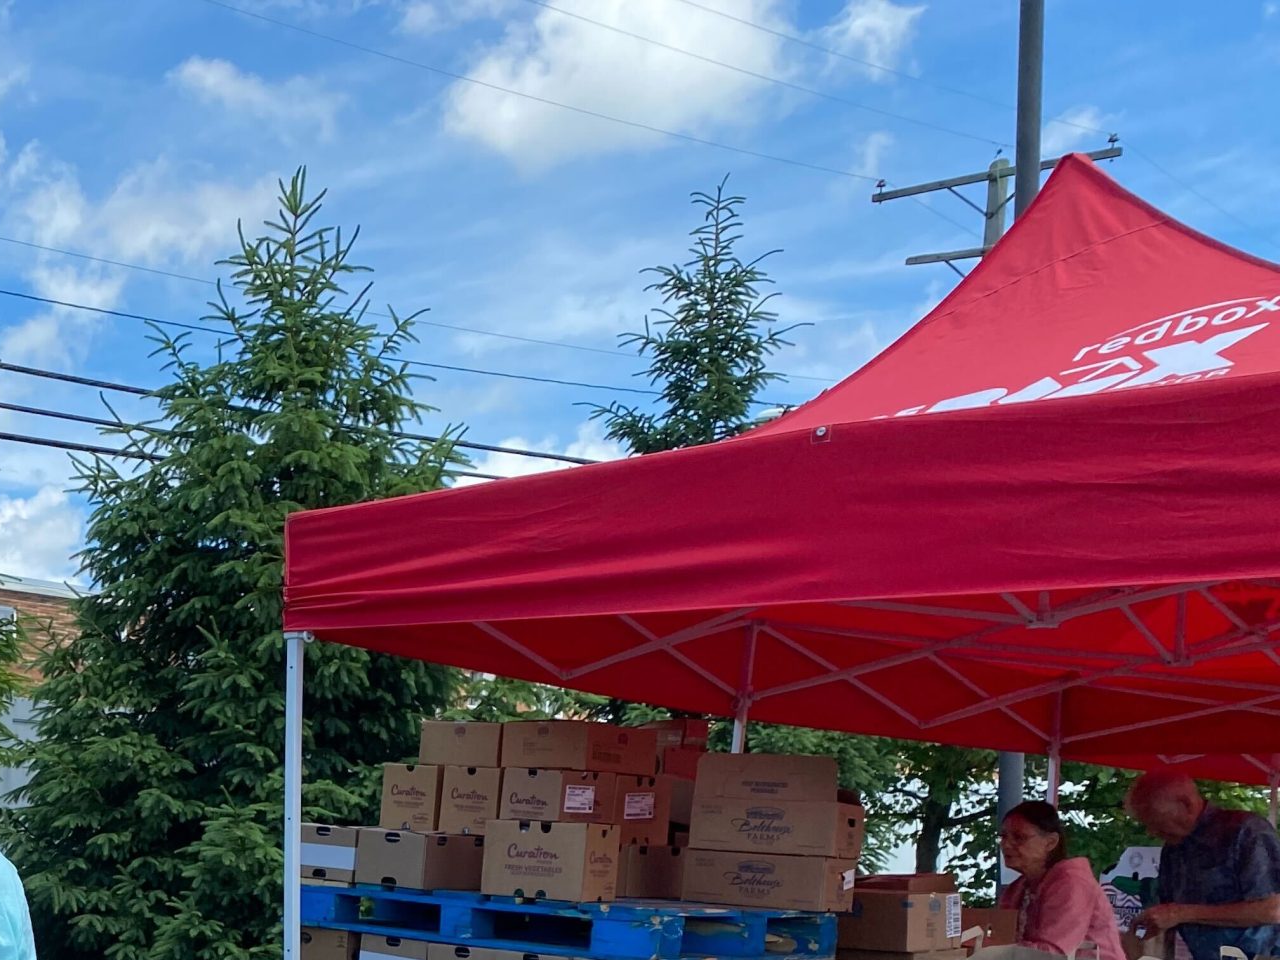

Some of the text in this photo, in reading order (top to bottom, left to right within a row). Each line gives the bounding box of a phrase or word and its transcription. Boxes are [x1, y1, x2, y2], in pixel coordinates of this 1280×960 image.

[1072, 295, 1280, 362] redbox
[510, 792, 548, 806] Curation
[507, 843, 559, 860] Curation
